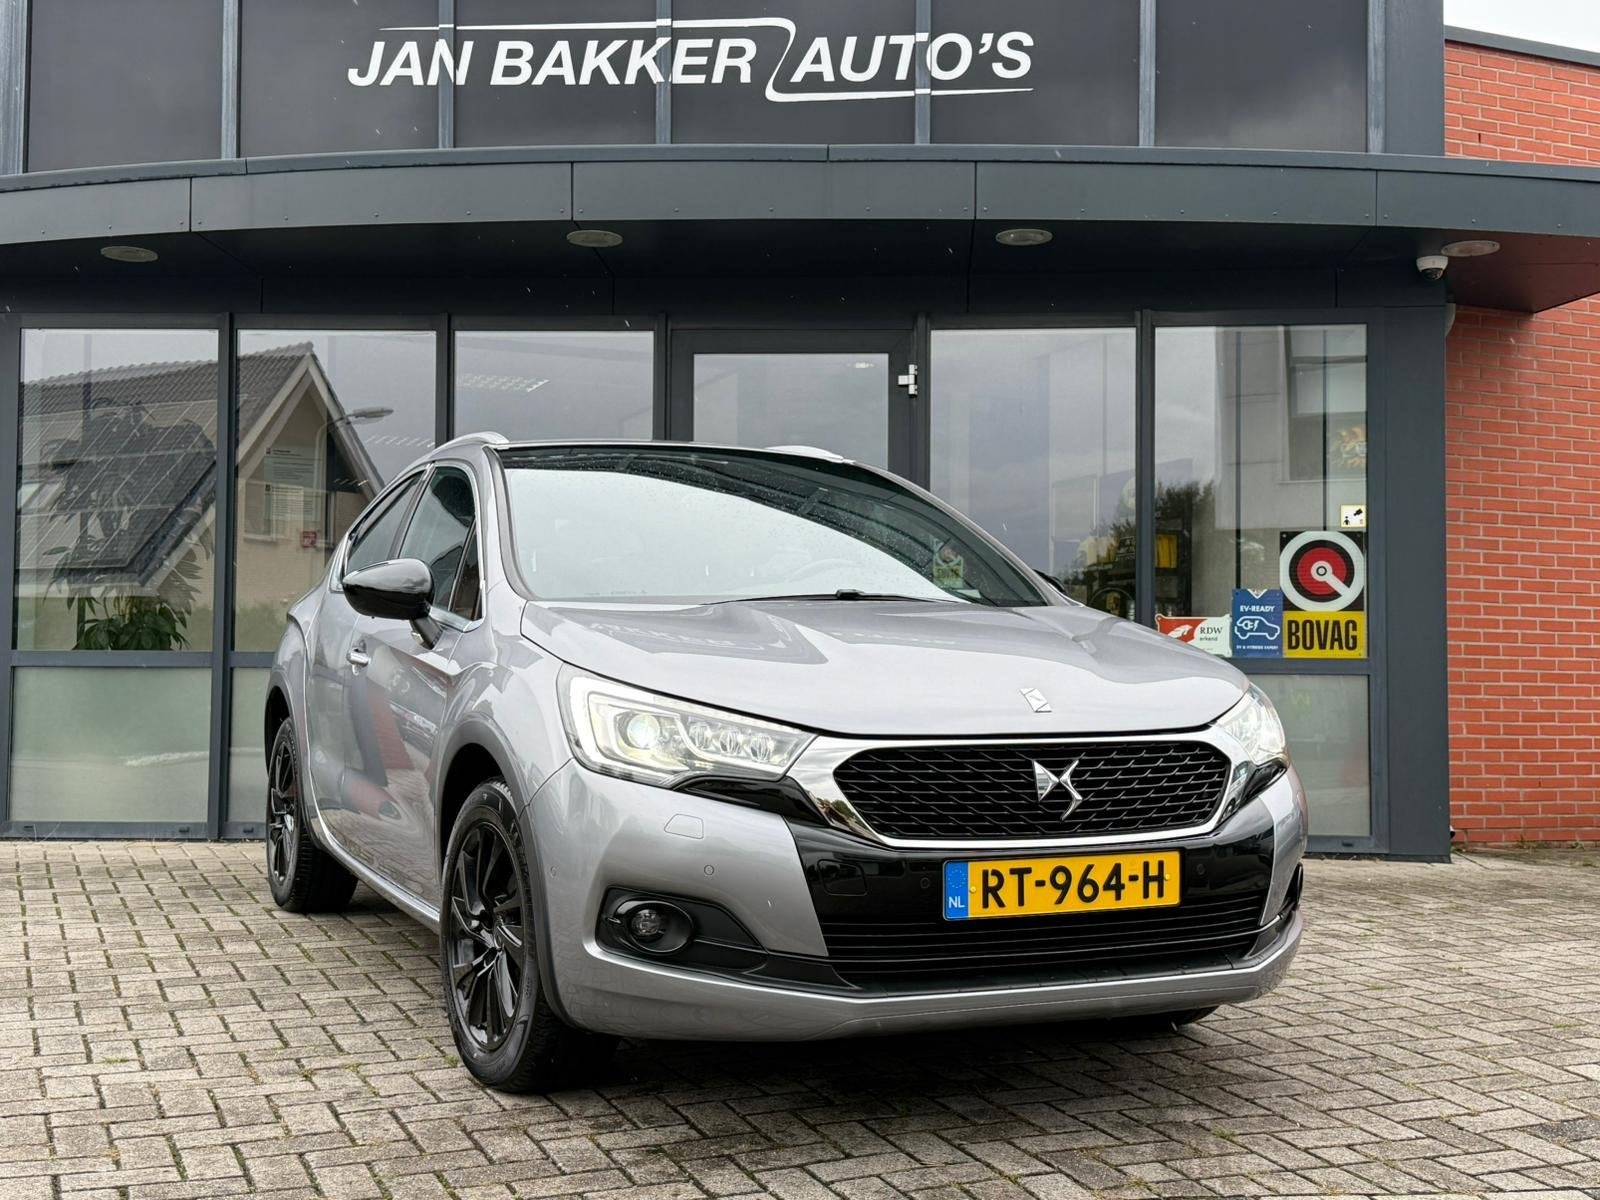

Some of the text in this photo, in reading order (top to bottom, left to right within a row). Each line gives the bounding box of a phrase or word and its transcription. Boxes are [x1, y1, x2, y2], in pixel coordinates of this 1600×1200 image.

[348, 31, 1034, 87] JAN BAKKER AUTO'S
[1240, 605, 1276, 613] EV-READY
[1200, 626, 1223, 635] RDW
[1287, 619, 1358, 650] BOVAG
[982, 860, 1165, 909] RT-964-H
[948, 895, 965, 908] NL
